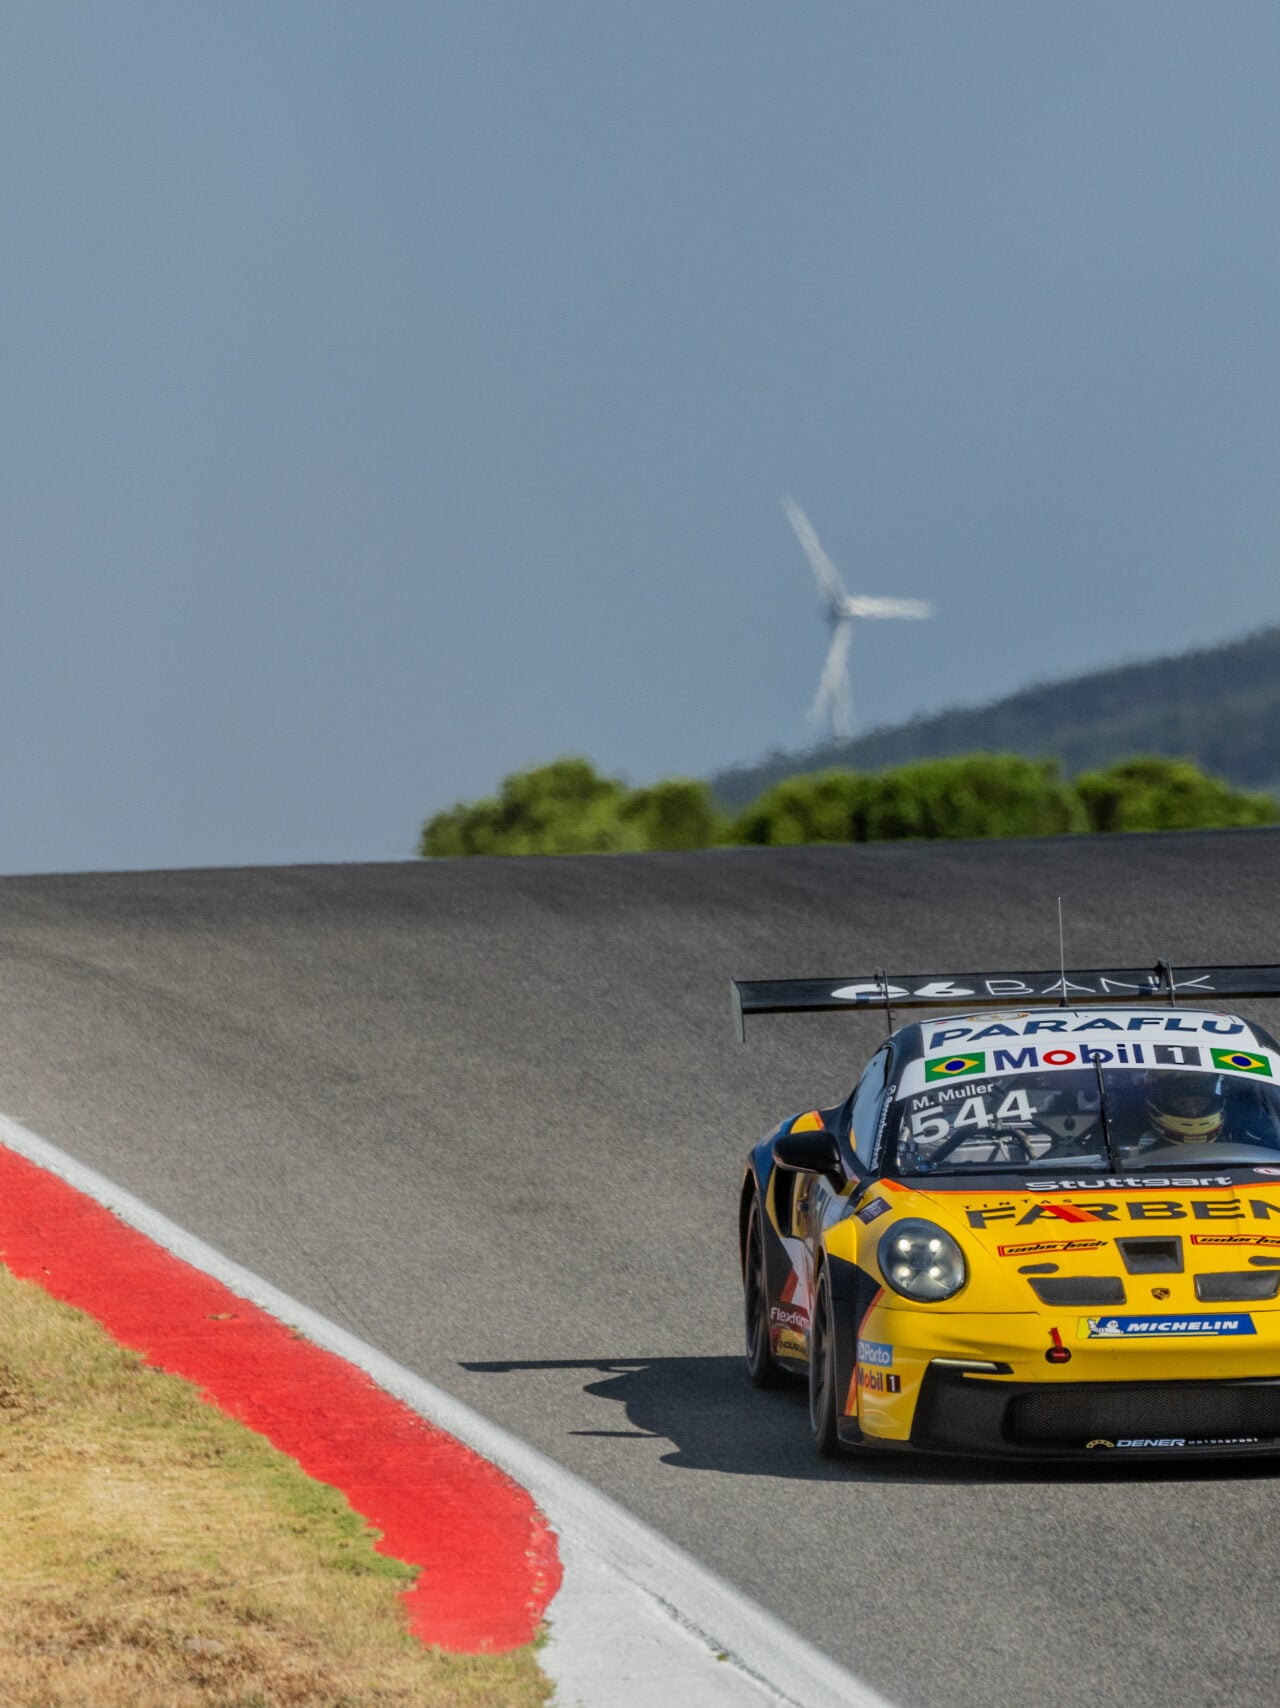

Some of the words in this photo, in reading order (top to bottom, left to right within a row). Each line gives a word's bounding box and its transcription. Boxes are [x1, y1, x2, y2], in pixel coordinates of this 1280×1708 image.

[985, 975, 1216, 996] BANK
[929, 1016, 1245, 1050] PARAFLU
[993, 1043, 1145, 1072] Mobil
[913, 1097, 934, 1111] M.
[938, 1083, 995, 1104] Muller
[911, 1089, 1038, 1145] 544
[1025, 1176, 1233, 1191] Stuttgart
[962, 1198, 1073, 1210] TINTAS
[1126, 1320, 1240, 1332] MICHELIN
[857, 1366, 884, 1392] Mobil
[1116, 1438, 1186, 1448] DENER
[1188, 1437, 1259, 1445] MOTORSPORT
